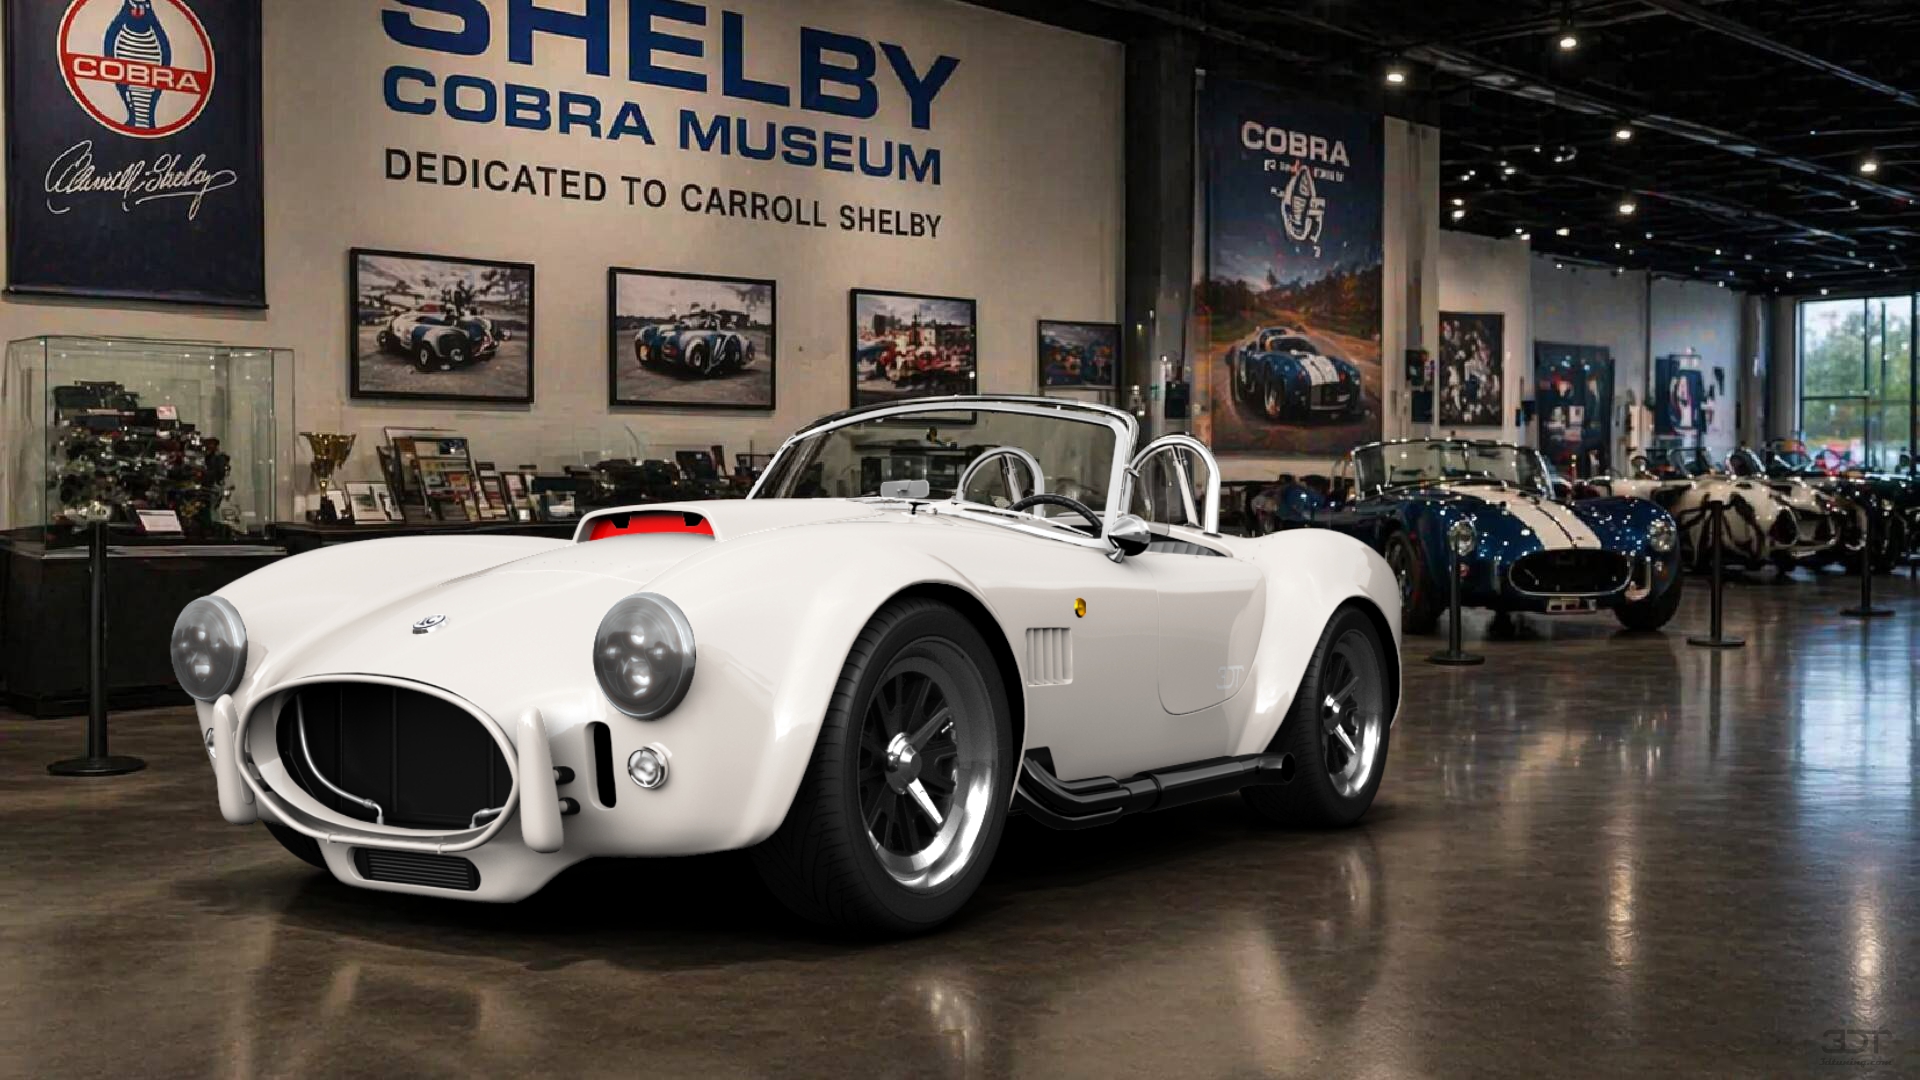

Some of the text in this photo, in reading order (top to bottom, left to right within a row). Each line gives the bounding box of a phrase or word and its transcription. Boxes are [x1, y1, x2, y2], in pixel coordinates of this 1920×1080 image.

[72, 57, 201, 92] COBRA
[381, 0, 961, 130] SHELBY
[383, 65, 941, 186] COBRA MUSEUM
[1241, 121, 1350, 167] COBRA
[385, 148, 941, 239] DEDICATED TO CARROLL SHELBY
